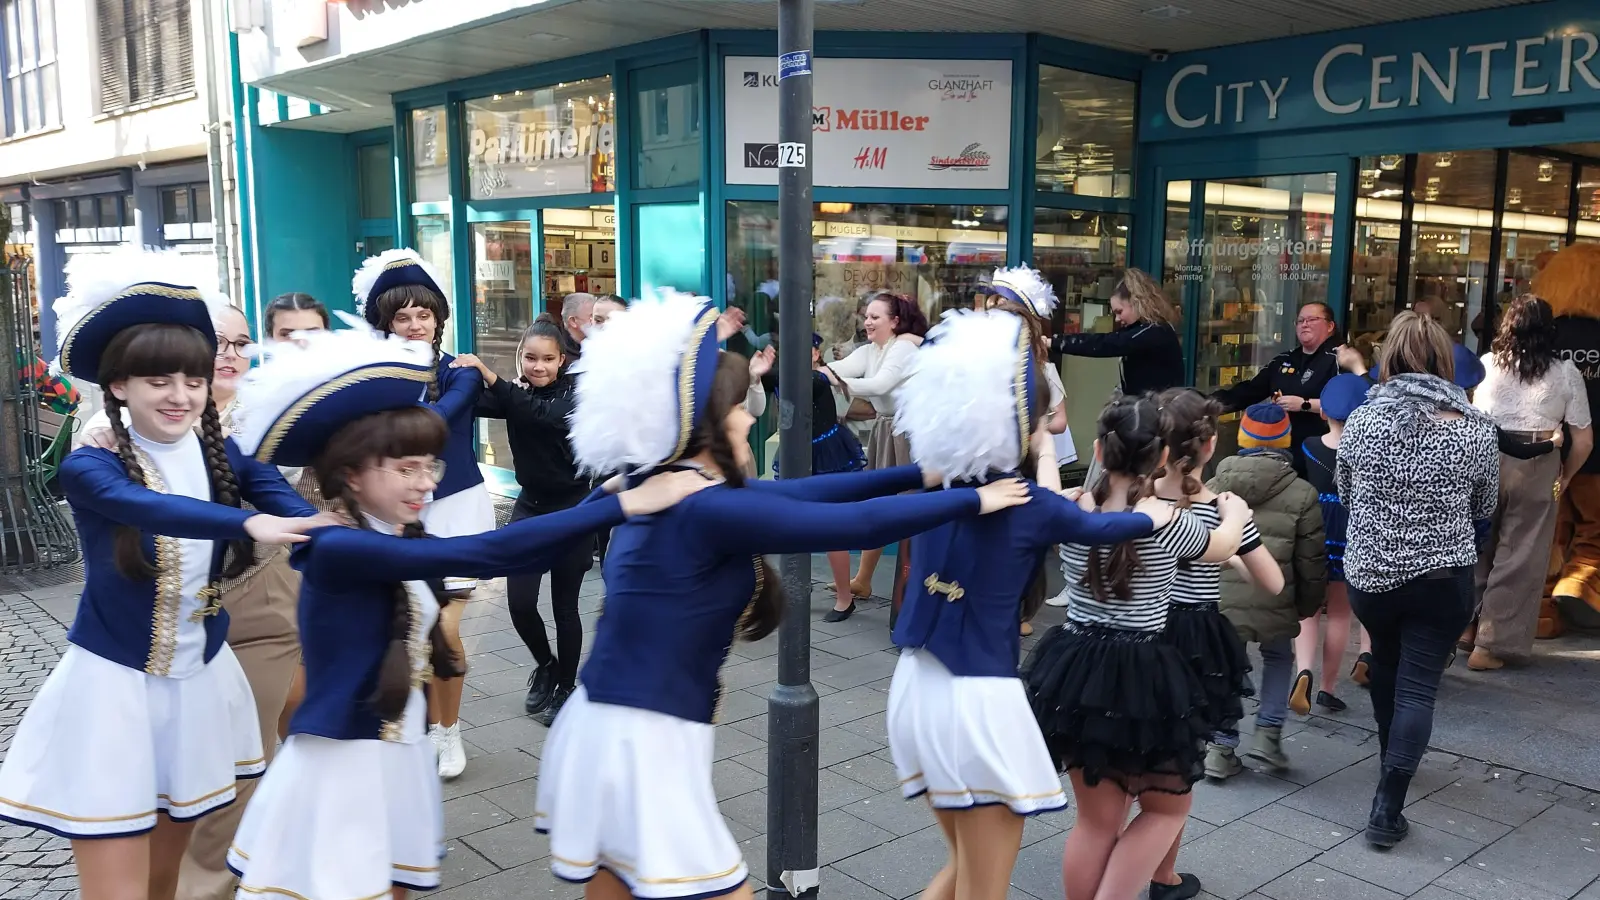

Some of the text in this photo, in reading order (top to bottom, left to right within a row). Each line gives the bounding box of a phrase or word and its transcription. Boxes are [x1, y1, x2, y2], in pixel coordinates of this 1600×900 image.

[928, 80, 994, 91] GLANZHAFT
[1165, 31, 1600, 128] CITY CENTER
[836, 109, 930, 131] Müller
[470, 122, 614, 166] Parfümerie
[853, 146, 888, 170] H&M
[830, 225, 867, 235] MUGLER
[1178, 236, 1317, 260] Öffnungszeiten
[843, 269, 911, 282] DEVOTON
[1174, 273, 1204, 281] Samstag
[1175, 264, 1202, 273] Montag
